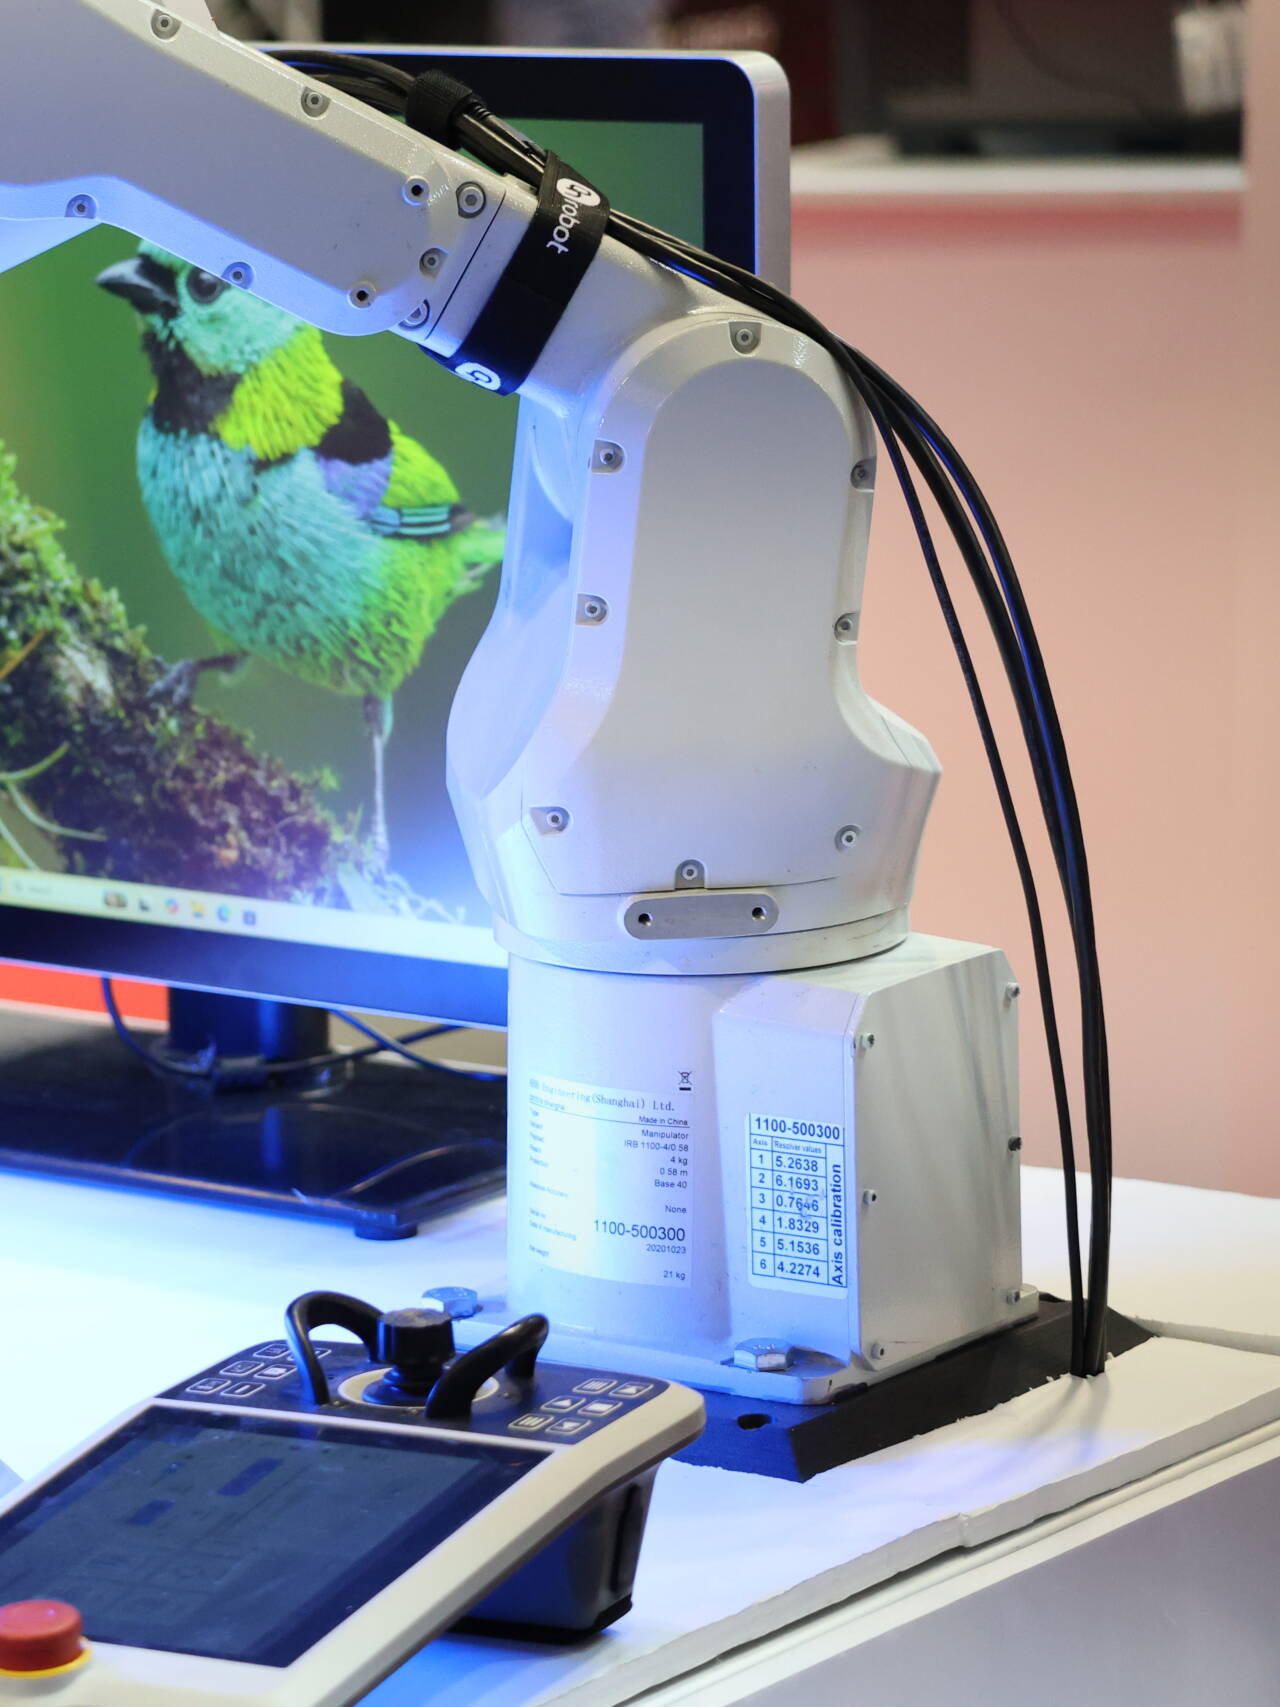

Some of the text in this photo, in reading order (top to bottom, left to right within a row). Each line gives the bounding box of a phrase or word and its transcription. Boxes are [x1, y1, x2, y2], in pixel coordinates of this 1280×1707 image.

[546, 198, 581, 254] robot
[638, 1115, 658, 1124] Made
[667, 1118, 689, 1126] China
[755, 1116, 840, 1140] 1100-500300
[641, 1129, 689, 1140] Manipulator
[624, 1139, 639, 1149] IRB
[752, 1138, 768, 1147] Axis
[678, 1156, 689, 1166] kg
[758, 1154, 818, 1172] 1 5.2638
[654, 1178, 688, 1189] Base 40
[758, 1173, 819, 1191] 2 6.1693
[758, 1193, 766, 1204] 3
[664, 1205, 687, 1214] None
[594, 1219, 686, 1241] 1100-500300
[759, 1215, 819, 1234] 4 1.8329
[830, 1164, 844, 1285] Axis calibration
[646, 1243, 687, 1254] 20201023
[759, 1236, 820, 1256] 5 5.1536
[760, 1258, 820, 1278] 6 4.2274
[663, 1270, 686, 1281] 21 kg
